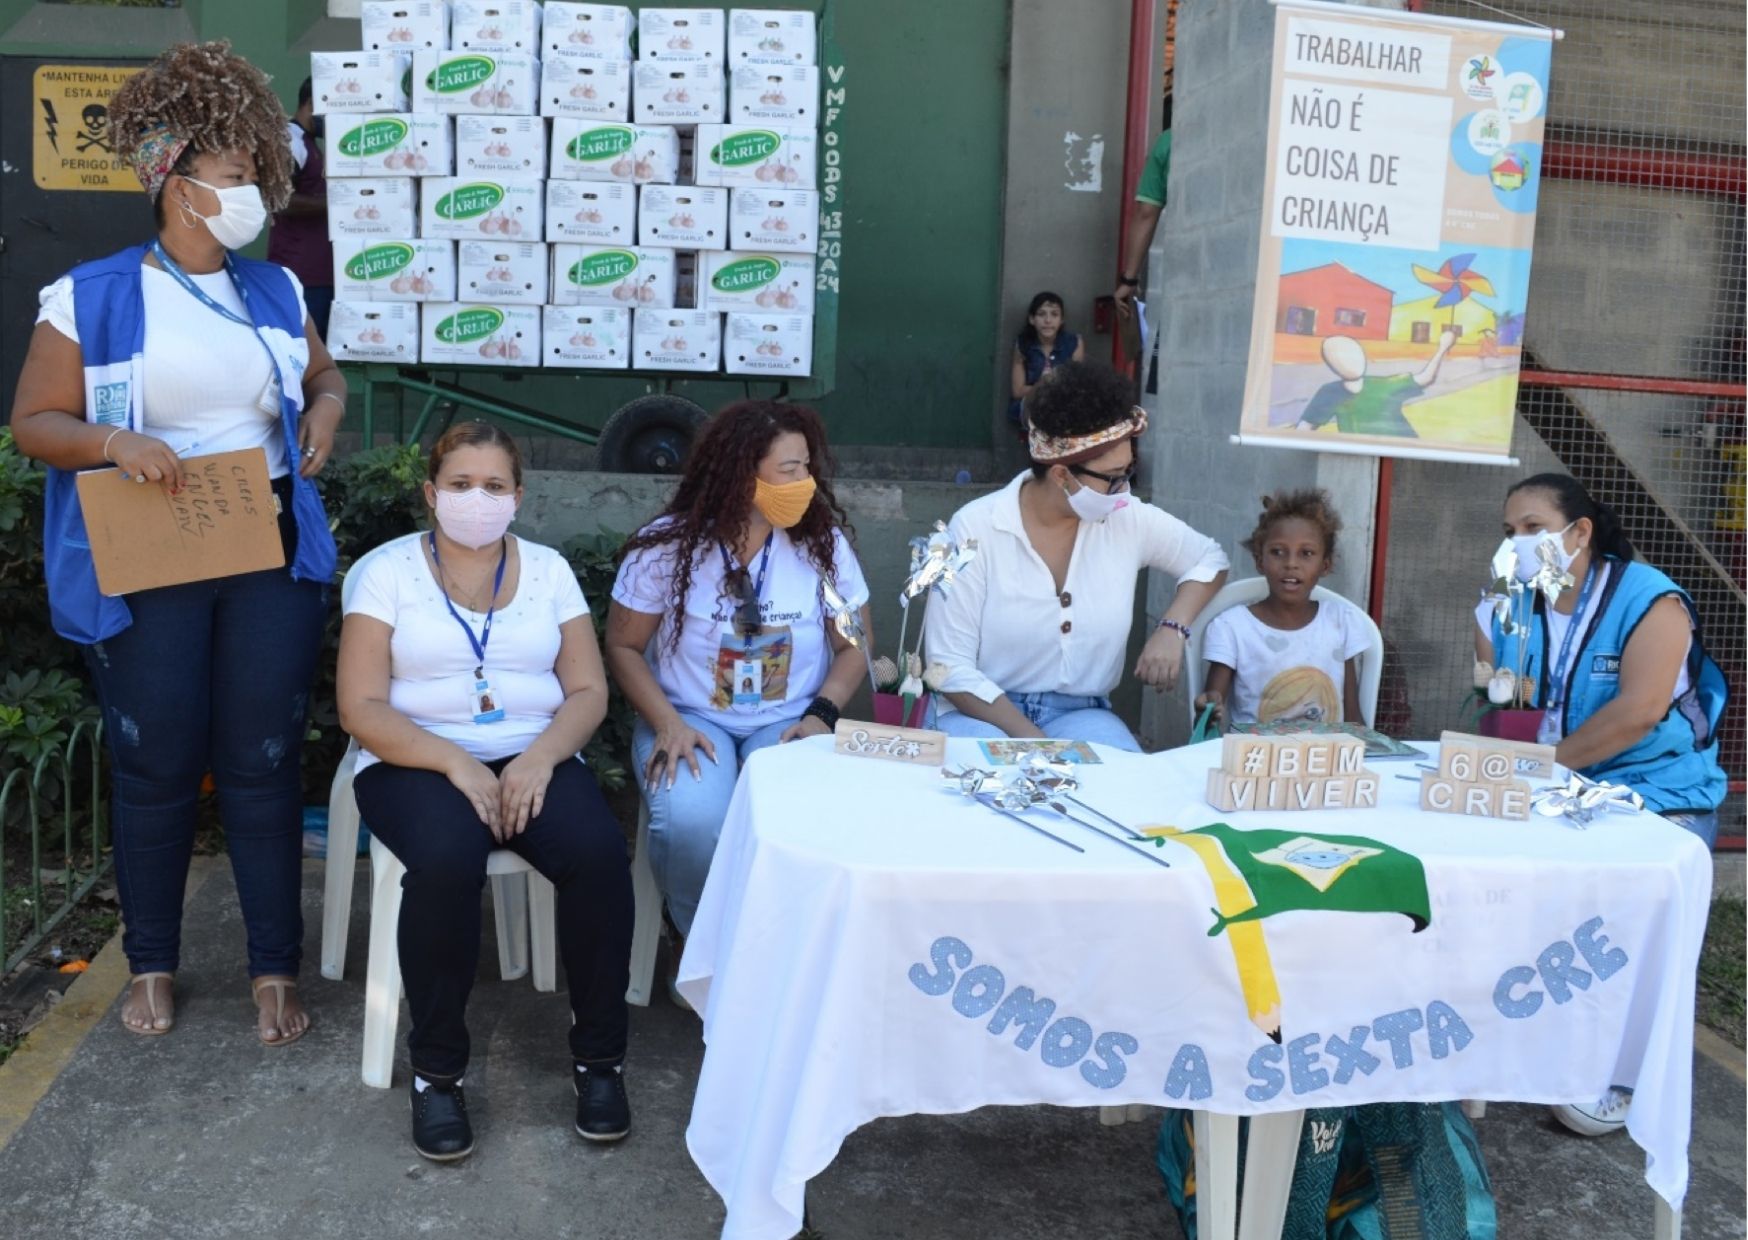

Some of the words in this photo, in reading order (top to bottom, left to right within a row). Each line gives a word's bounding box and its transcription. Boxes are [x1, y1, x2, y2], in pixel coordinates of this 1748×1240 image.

[1295, 33, 1423, 74] TRABALHAR
[47, 71, 109, 83] MANTENHA
[113, 72, 131, 84] LIV
[438, 67, 487, 89] GARLIC
[64, 87, 92, 98] ESTA
[1290, 87, 1342, 130] NÃO
[1350, 93, 1364, 132] É
[347, 130, 401, 153] GARLIC
[721, 142, 772, 161] GARLIC
[61, 159, 108, 170] PERIGO
[111, 160, 129, 171] DE
[1285, 144, 1360, 183] COISA
[1369, 153, 1400, 186] DE
[80, 175, 109, 185] VIDA
[443, 194, 495, 216] GARLIC
[1281, 195, 1390, 241] CRIANÇA
[353, 253, 406, 276] GARLIC
[579, 262, 630, 282] GARLIC
[820, 259, 838, 272] A
[720, 268, 772, 289] GARLIC
[815, 274, 840, 293] 24
[443, 317, 496, 339] GARLIC
[1244, 746, 1365, 775] #BEM
[1230, 779, 1376, 809] VIVER
[1428, 782, 1526, 818] CRE
[908, 936, 1139, 1089] SOMOS
[1164, 1043, 1213, 1100] A
[1245, 1000, 1474, 1102] SEXTA
[1492, 915, 1629, 1019] CRE
